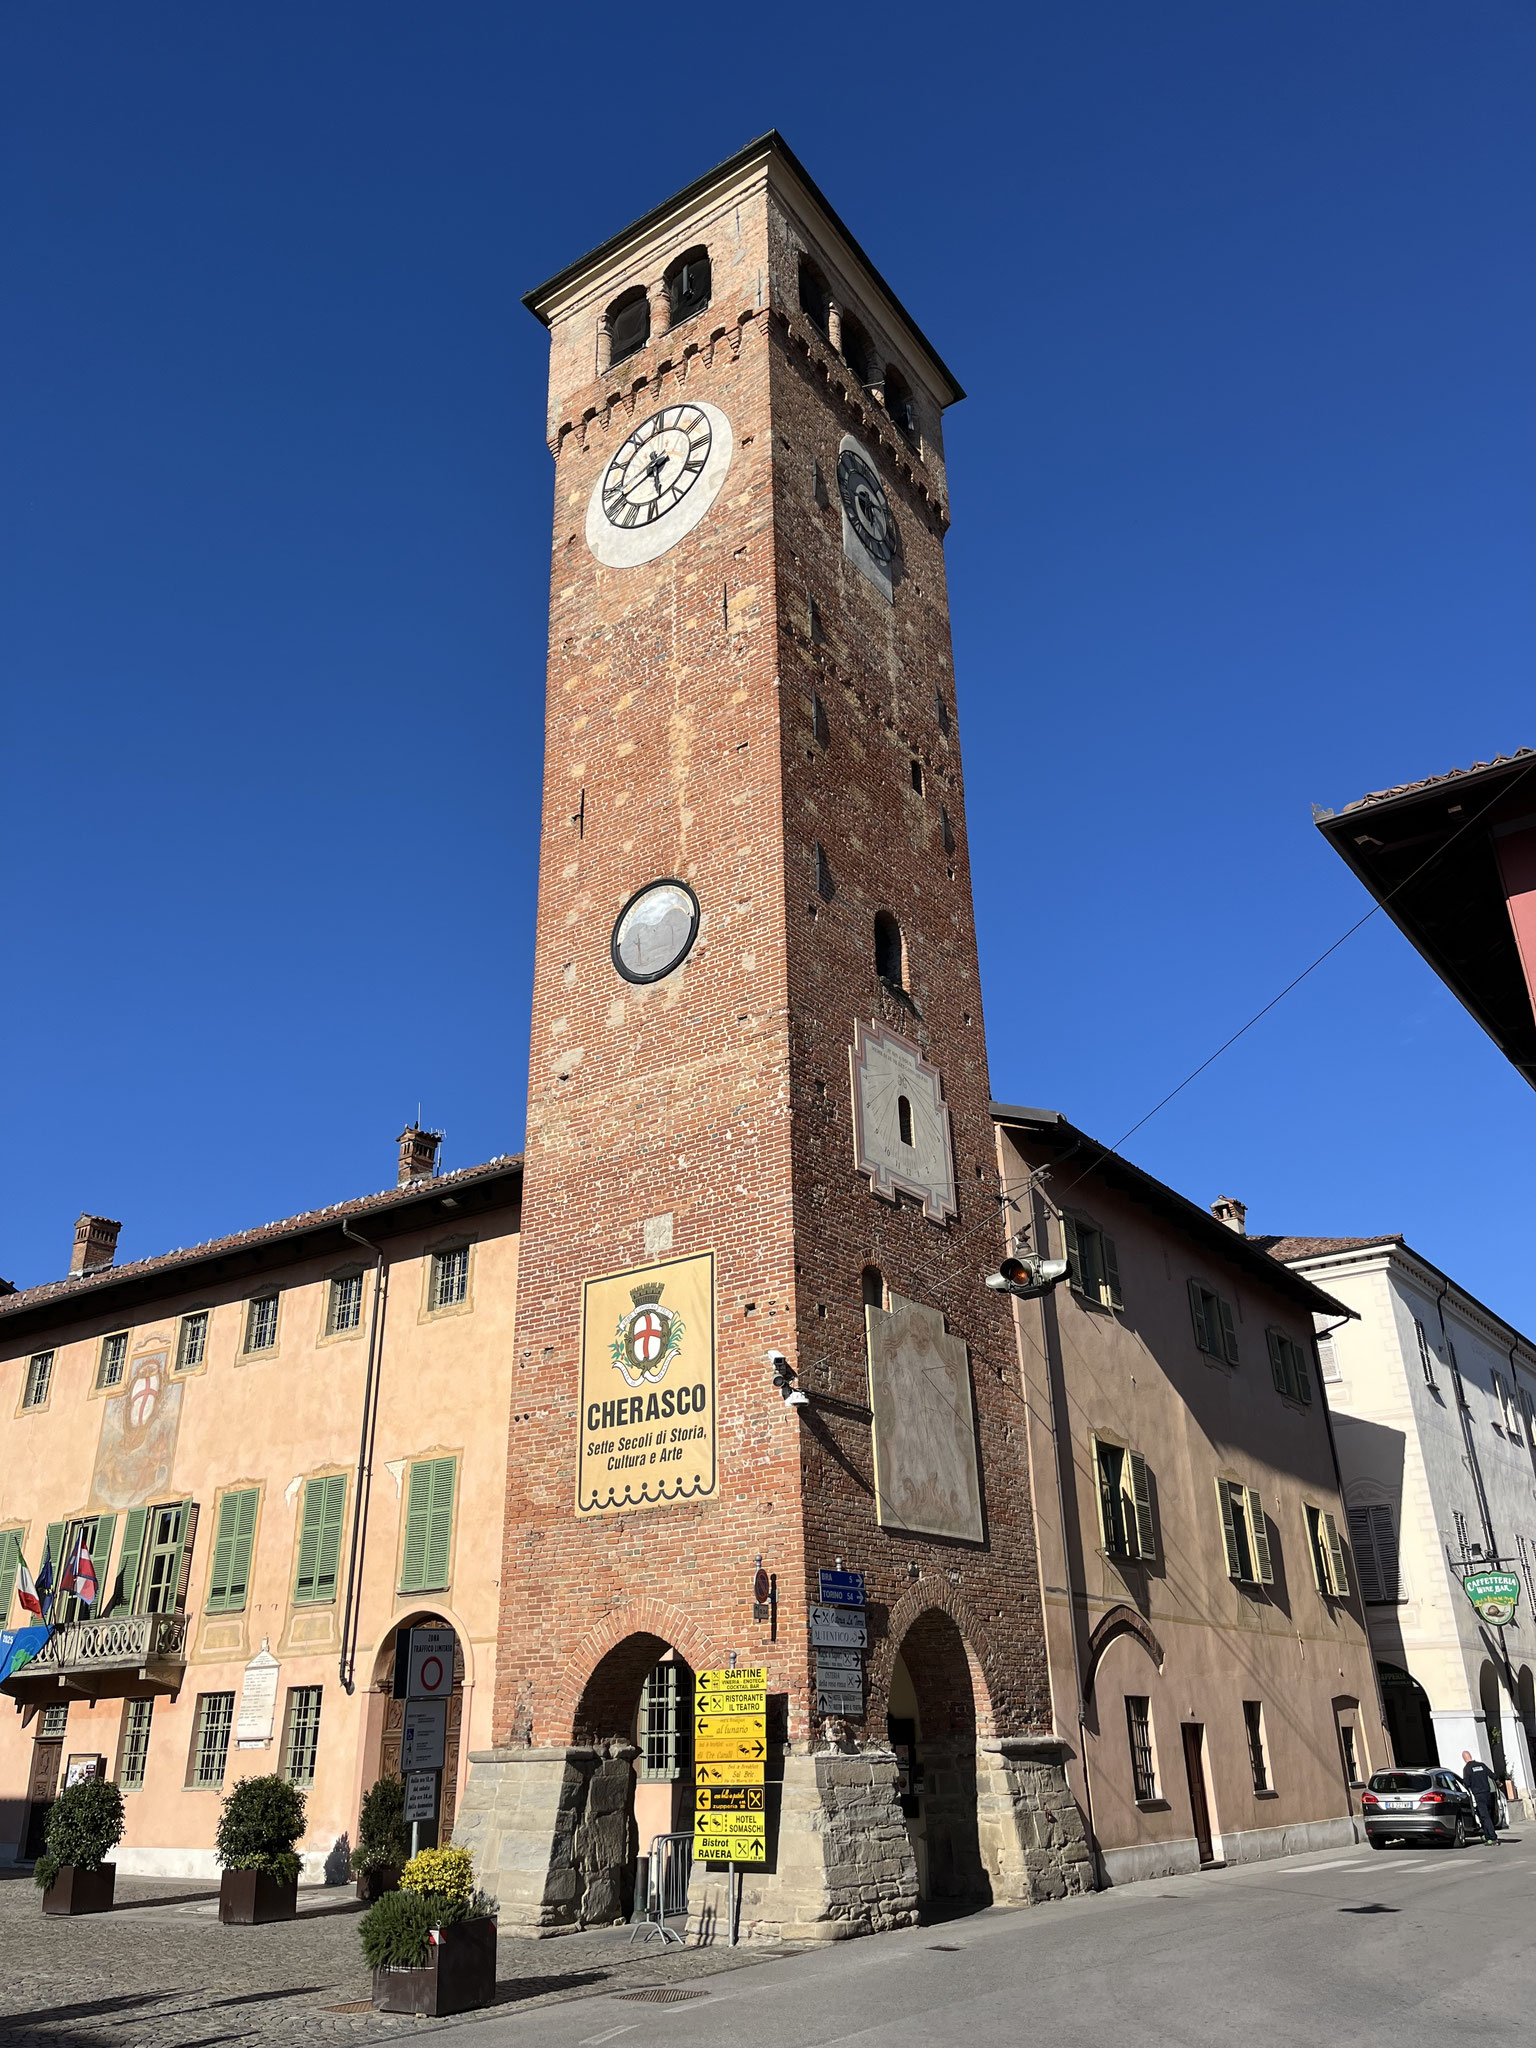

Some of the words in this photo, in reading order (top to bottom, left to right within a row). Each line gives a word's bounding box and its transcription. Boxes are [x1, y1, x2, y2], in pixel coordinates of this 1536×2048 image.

[587, 1383, 706, 1431] CHERASCO
[587, 1440, 615, 1457] Sette
[618, 1432, 653, 1452] Secoli
[655, 1429, 667, 1446] di
[670, 1425, 707, 1443] Storia,
[607, 1453, 646, 1471] Cultura
[649, 1452, 656, 1465] e
[659, 1447, 683, 1463] Arte
[822, 1572, 833, 1582] BRA
[1466, 1576, 1516, 1592] CAFFETTERIA
[1476, 1585, 1494, 1594] WINE
[1494, 1584, 1512, 1594] BAR
[822, 1590, 843, 1600] TORINO
[428, 1634, 440, 1642] ZONA
[414, 1644, 434, 1652] TRAFFICO
[435, 1644, 452, 1652] LIMITATO
[724, 1668, 762, 1679] SARTINE
[726, 1694, 764, 1702] RISTORANTE
[736, 1703, 760, 1711] TEATRO
[729, 1824, 763, 1832] SOMASCHI
[702, 1838, 728, 1847] Bistrot
[698, 1850, 732, 1858] RAVERA
